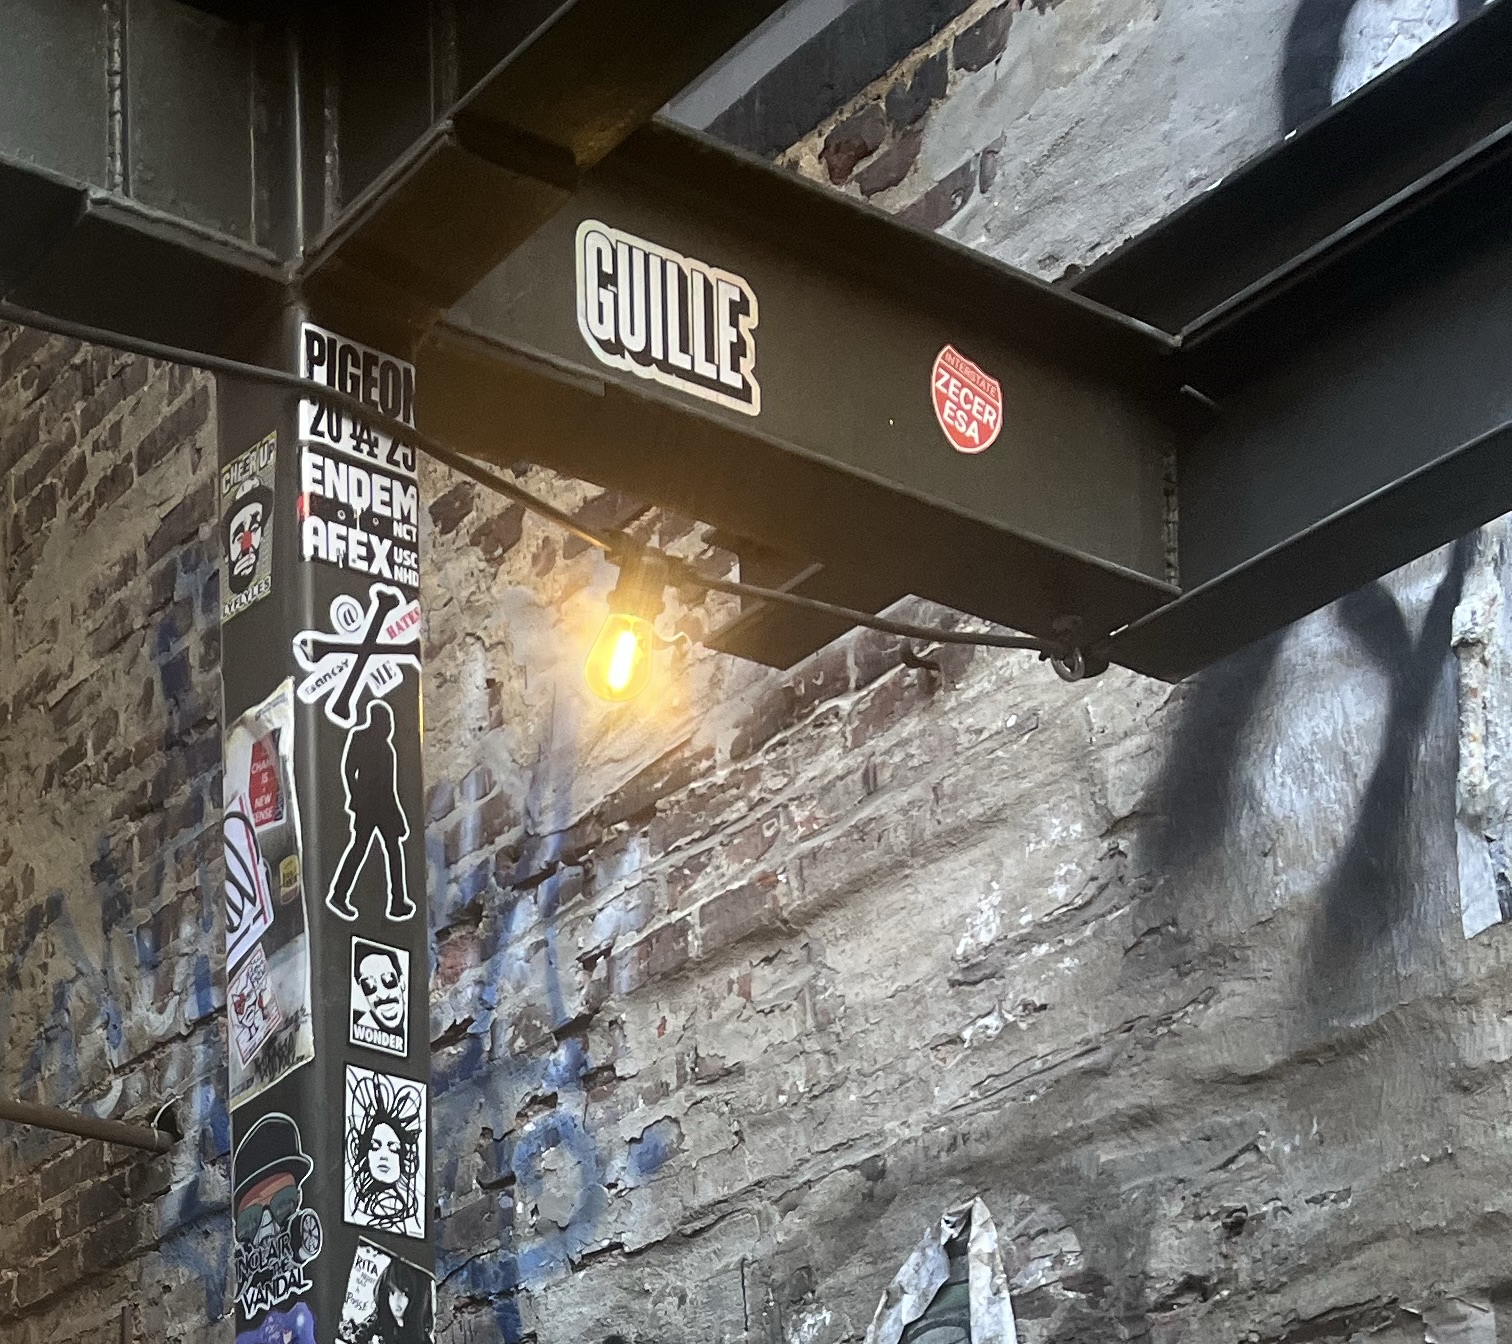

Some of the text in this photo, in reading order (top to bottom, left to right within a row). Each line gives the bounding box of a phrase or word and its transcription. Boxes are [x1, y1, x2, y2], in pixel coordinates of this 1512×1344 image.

[585, 229, 744, 389] GUILLE
[943, 352, 998, 396] INTERSTATE
[935, 367, 998, 430] ZECER
[942, 403, 980, 444] ESA
[303, 516, 392, 578] AFEX
[393, 548, 418, 568] USC
[353, 1024, 405, 1050] WONDER
